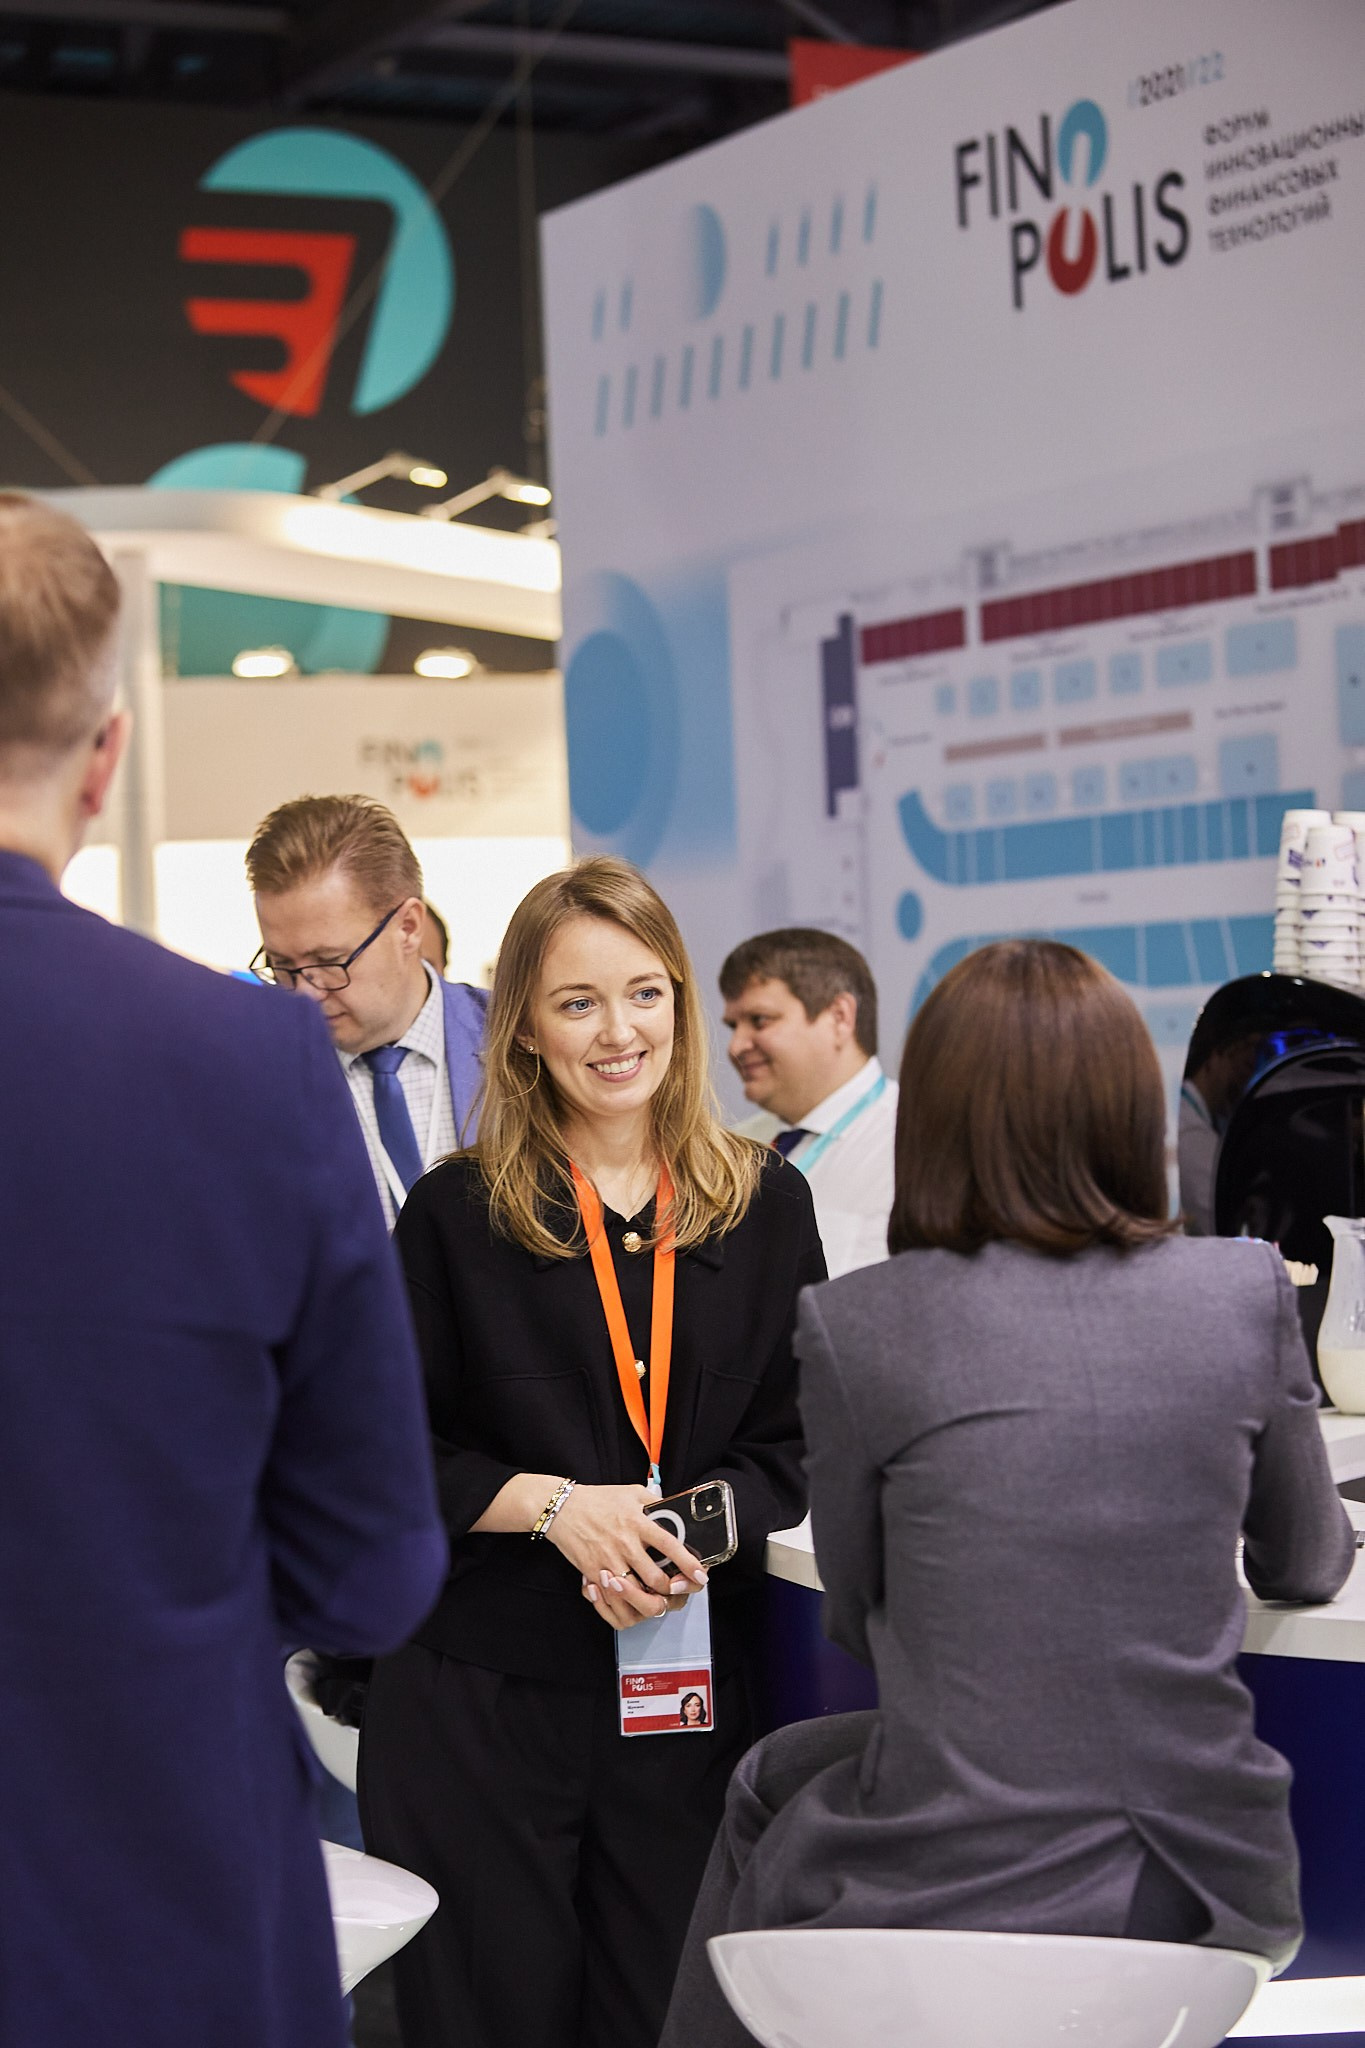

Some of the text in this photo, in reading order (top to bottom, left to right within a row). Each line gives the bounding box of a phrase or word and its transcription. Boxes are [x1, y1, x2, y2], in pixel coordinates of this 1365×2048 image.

[1205, 111, 1270, 145] ФОРУМ
[1206, 113, 1365, 179] ИННОВАЦИОННЫ
[956, 98, 1108, 229] FINO
[1209, 159, 1338, 216] ФИНАНСОВЫХ
[1012, 170, 1190, 309] POLIS
[1209, 191, 1331, 250] ТЕХНОЛОГИЙ
